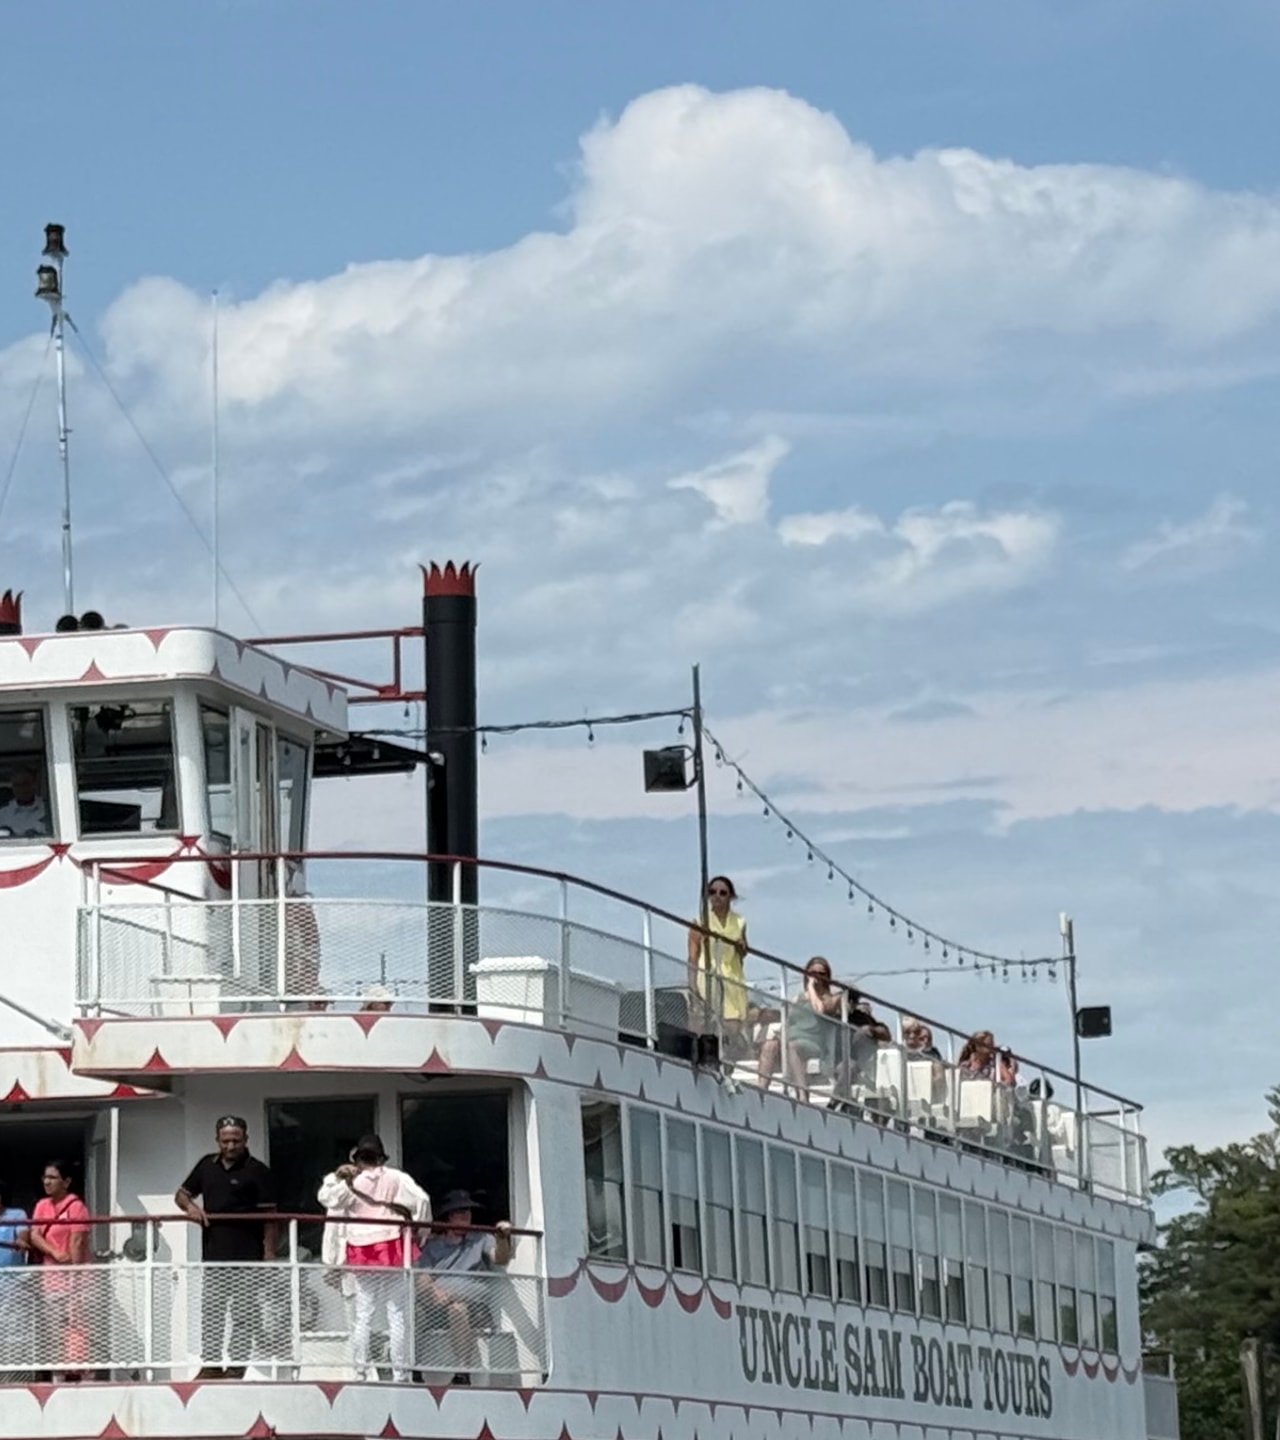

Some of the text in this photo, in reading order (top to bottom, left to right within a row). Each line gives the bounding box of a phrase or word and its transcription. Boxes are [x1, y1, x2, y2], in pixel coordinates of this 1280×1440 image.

[736, 1304, 1053, 1419] UNCLE SAM BOAT TOURS
